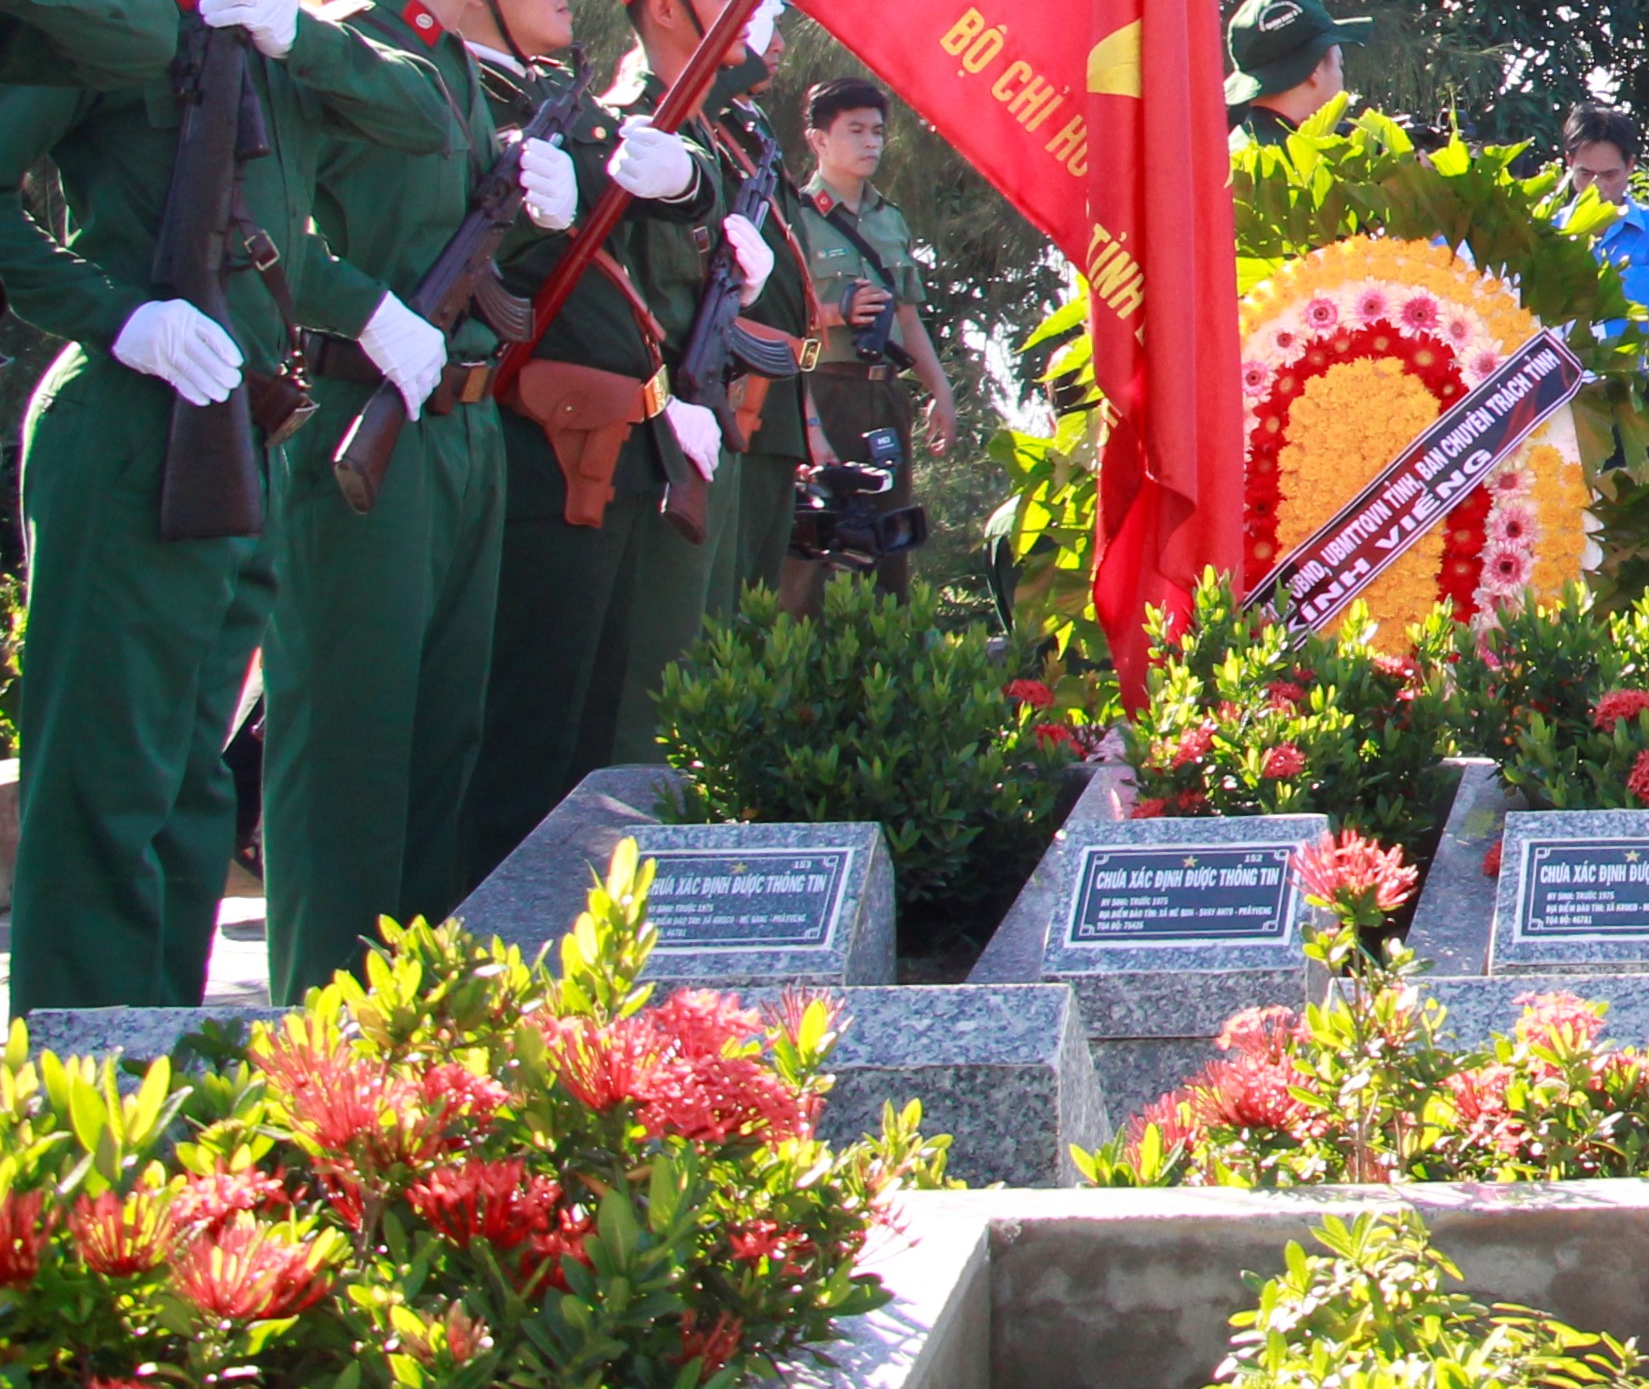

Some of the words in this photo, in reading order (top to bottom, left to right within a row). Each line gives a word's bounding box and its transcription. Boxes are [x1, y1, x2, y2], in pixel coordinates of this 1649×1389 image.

[939, 7, 1008, 77] BỘ
[989, 59, 1070, 132] CHỈ
[1085, 222, 1145, 320] TỈNH
[1320, 500, 1392, 568] UBMTTQVN
[1414, 450, 1449, 480] BAN
[1442, 406, 1496, 458] CHUYÊN
[1485, 376, 1529, 426] TRÁCH
[1522, 347, 1561, 389] TỈNH
[1375, 448, 1492, 551] VIẾNG
[675, 873, 702, 895] XÁC
[764, 870, 807, 893] THÔNG
[805, 874, 828, 892] TIN
[1095, 868, 1129, 889] CHƯA
[1129, 866, 1154, 888] XÁC
[1154, 869, 1184, 891] ĐỊNH
[1184, 866, 1218, 890] ĐƯỢC
[1218, 863, 1258, 886] THÔNG
[1258, 867, 1280, 885] TIN
[1244, 854, 1263, 862] 152
[1540, 863, 1571, 883] CHƯA
[1573, 861, 1596, 882] XÁC
[1599, 864, 1627, 886] ĐỊNH
